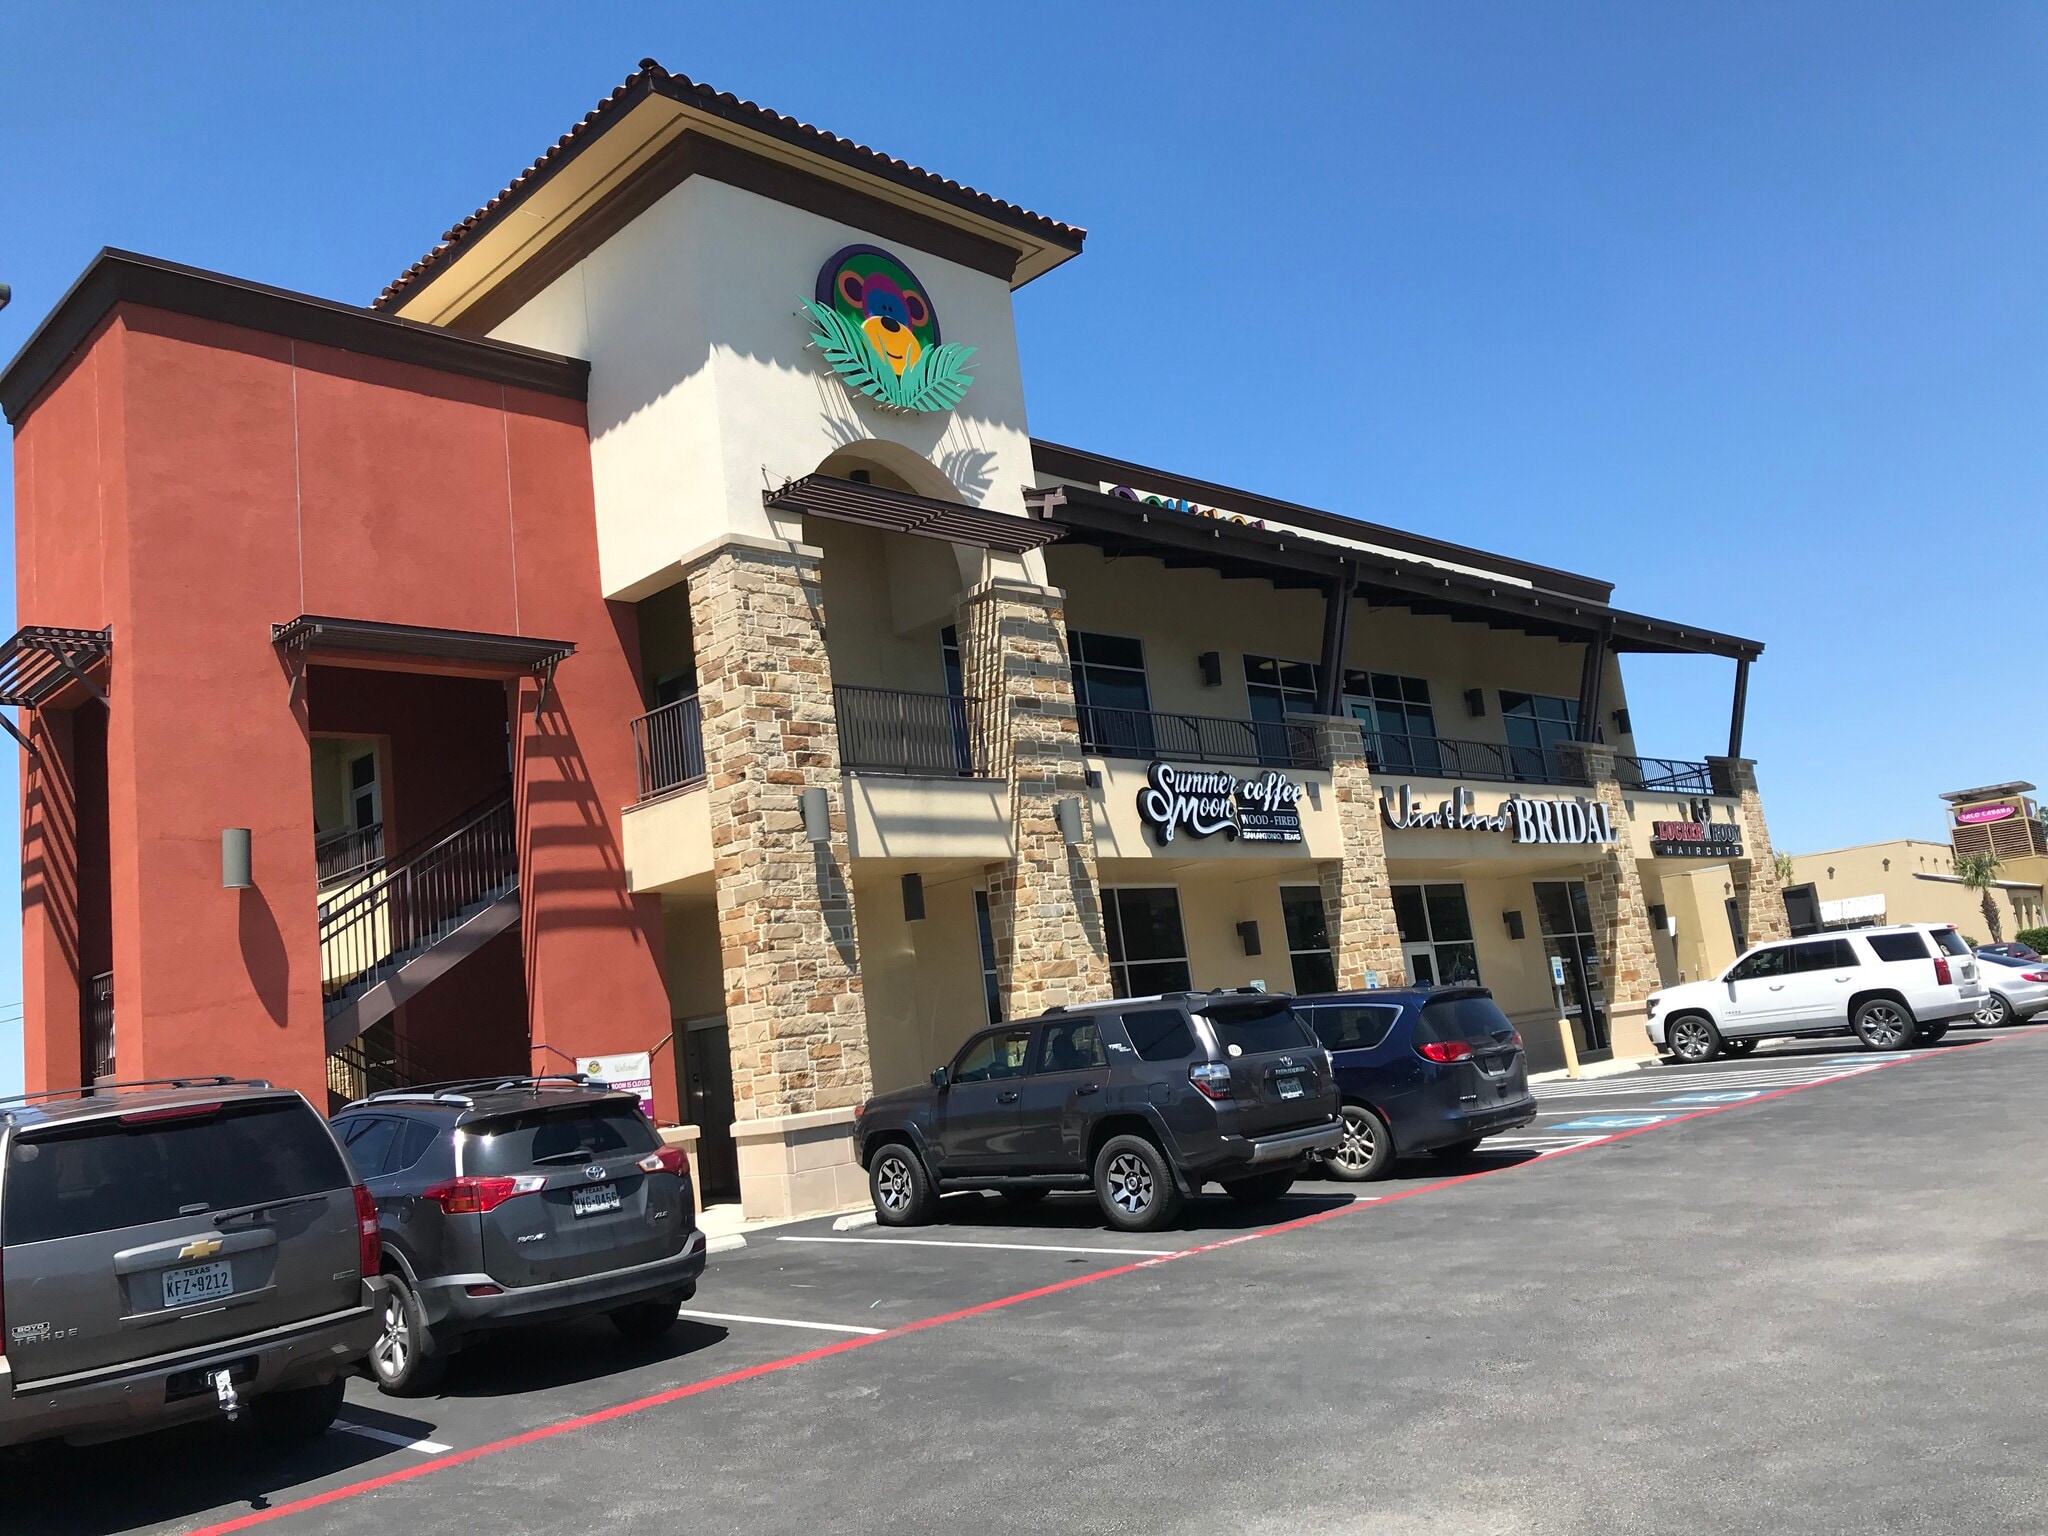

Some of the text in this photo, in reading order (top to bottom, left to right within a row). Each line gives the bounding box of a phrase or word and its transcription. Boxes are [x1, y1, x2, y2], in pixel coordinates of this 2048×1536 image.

[1157, 763, 1303, 812] Summer coffee
[1241, 815, 1269, 825] WOOD
[1274, 816, 1298, 826] FIRED
[1513, 799, 1619, 844] BRIDAL
[1659, 821, 1740, 842] LOCKER ROOM
[1666, 845, 1740, 856] HAIRCUTS
[184, 1267, 211, 1277] TEXAS
[14, 1328, 78, 1346] TAHOE
